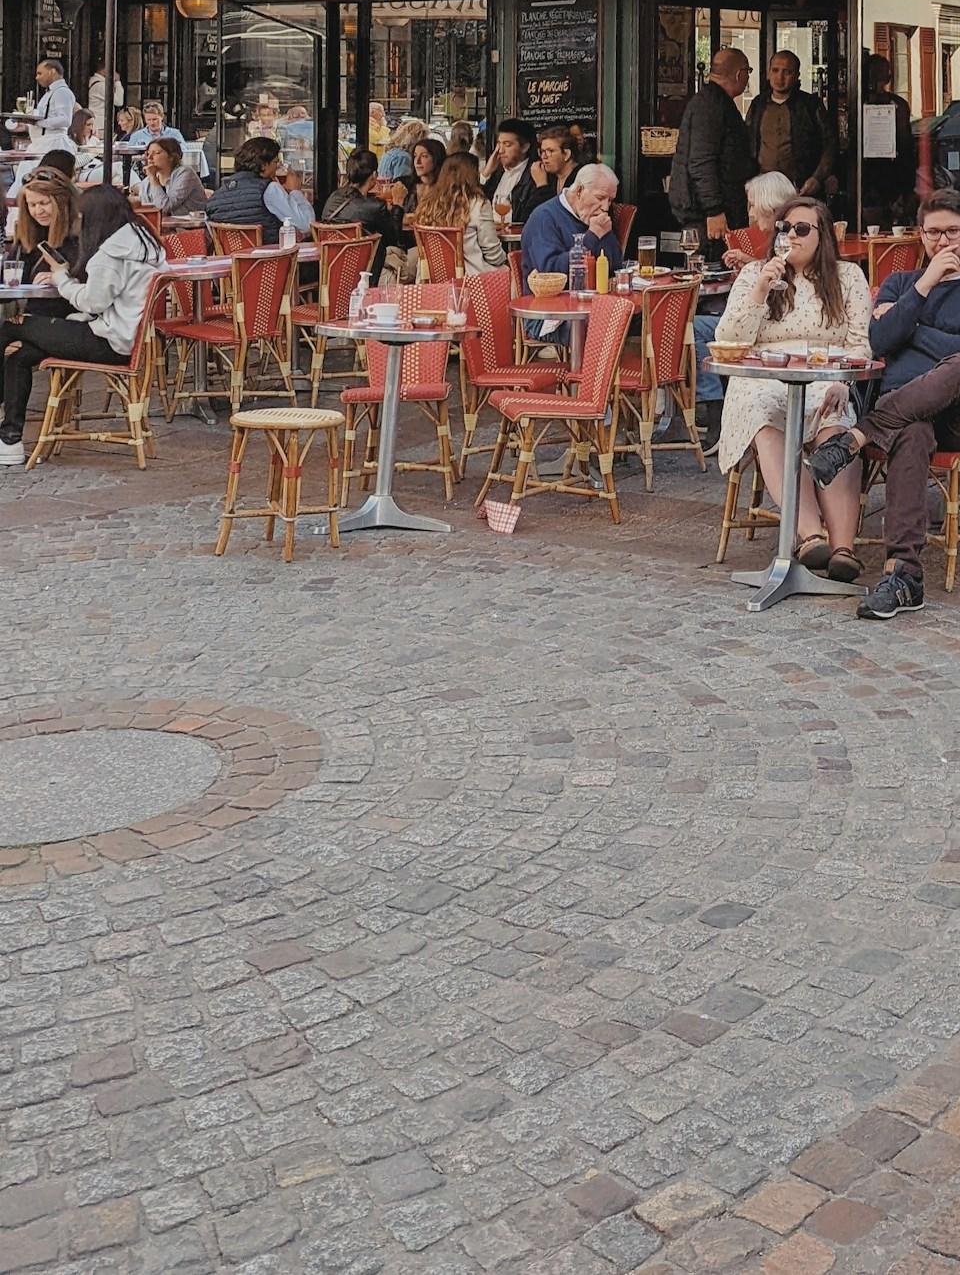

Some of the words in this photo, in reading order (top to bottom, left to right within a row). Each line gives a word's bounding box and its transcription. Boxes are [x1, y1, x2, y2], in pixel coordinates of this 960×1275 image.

[527, 81, 537, 93] LE
[529, 94, 540, 106] DU
[541, 93, 562, 104] CHEF
